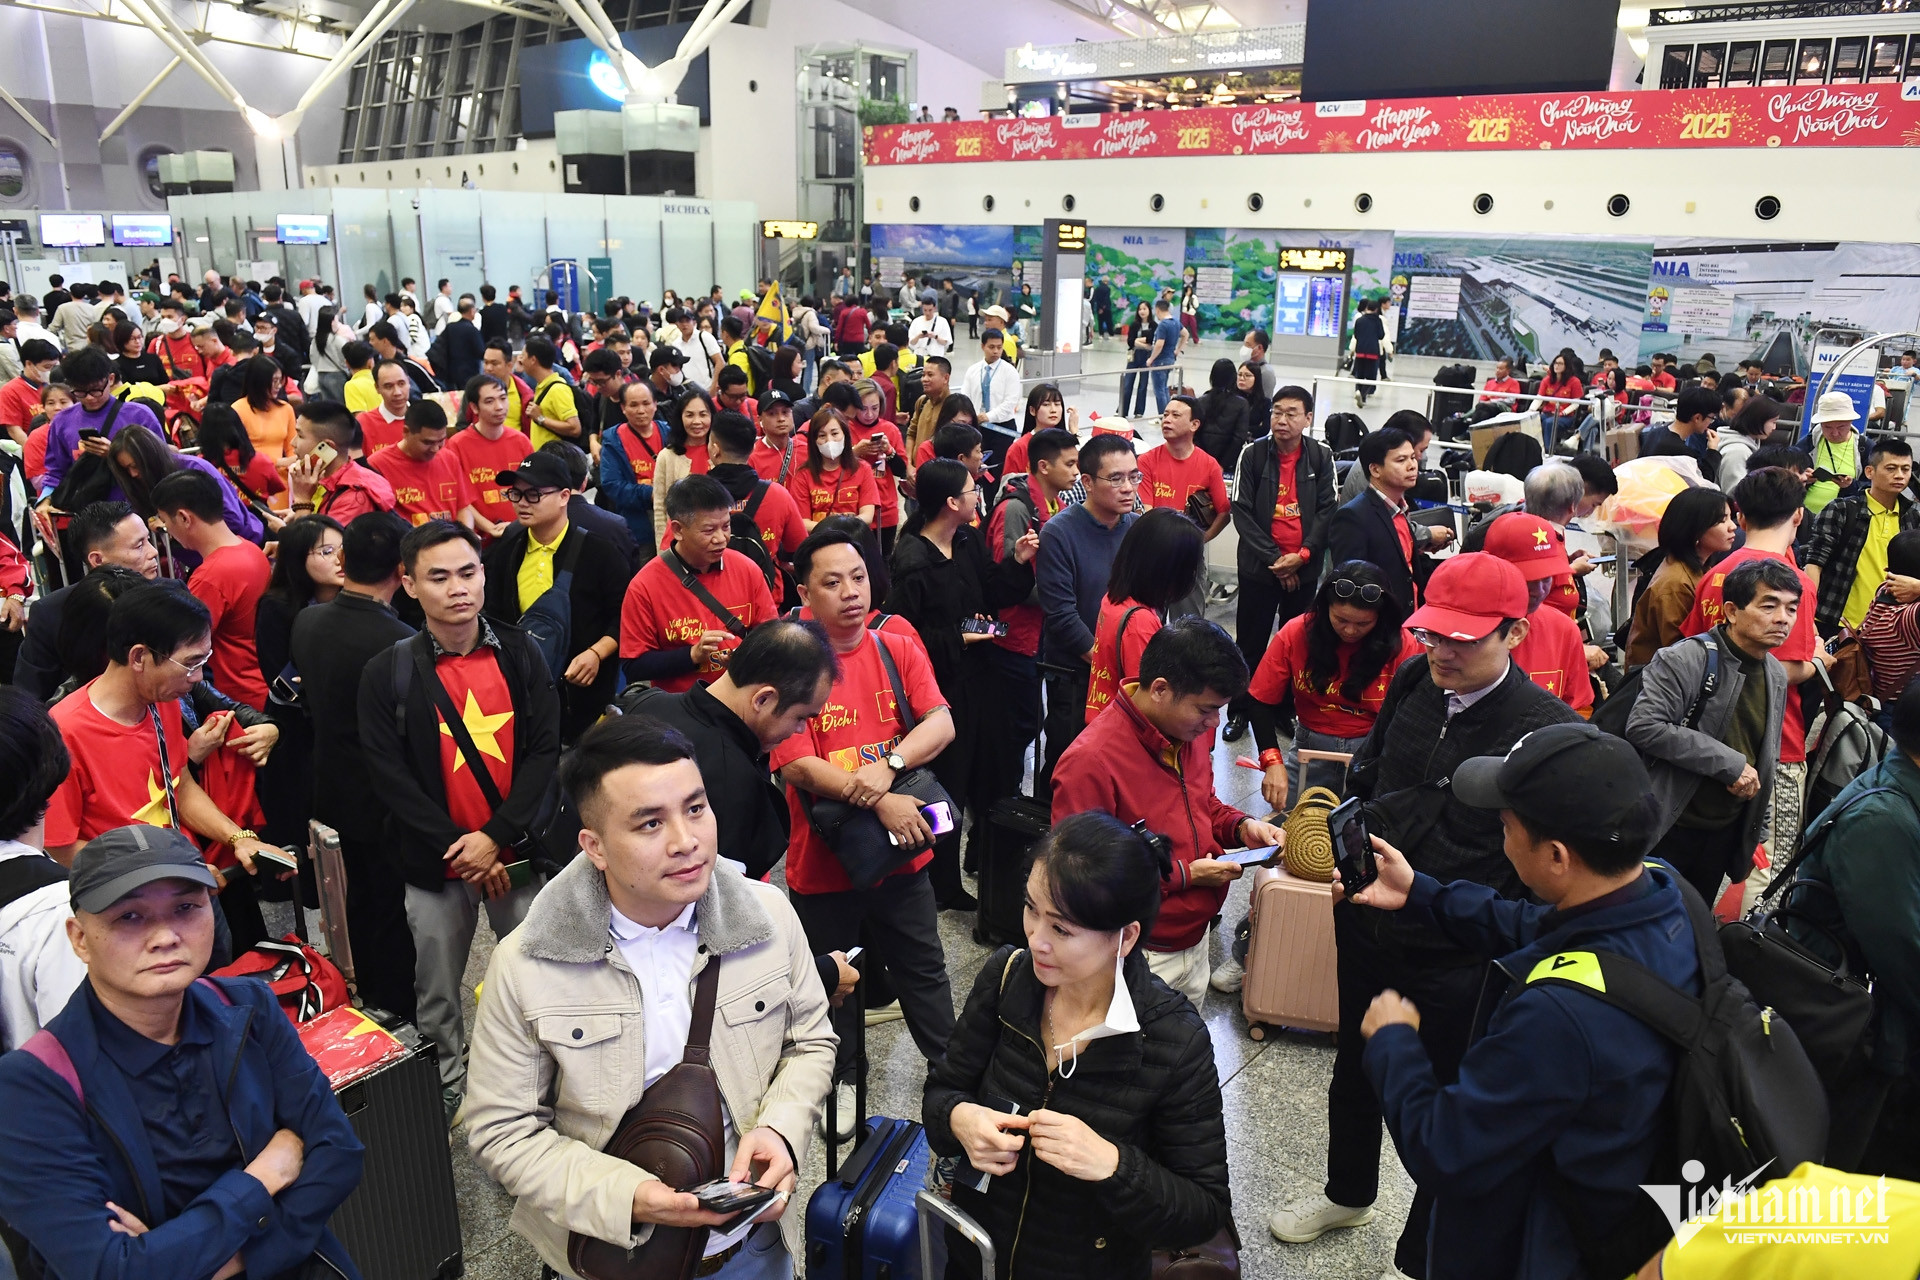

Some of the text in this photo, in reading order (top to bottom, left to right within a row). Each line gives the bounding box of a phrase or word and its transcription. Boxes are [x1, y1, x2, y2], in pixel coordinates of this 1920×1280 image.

[1319, 104, 1340, 113] ACV
[1371, 106, 1432, 131] Happy
[1103, 118, 1150, 139] Happy
[1356, 120, 1441, 150] New Year
[1467, 118, 1511, 142] 2025
[1679, 113, 1733, 139] 2025
[898, 129, 934, 148] Happy
[955, 137, 981, 156] 2025
[1094, 131, 1158, 156] New Year
[1177, 128, 1211, 149] 2025
[890, 140, 940, 163] New Year
[664, 204, 711, 215] RECHECK
[1123, 236, 1143, 245] NIA
[1394, 253, 1425, 266] NIA
[1653, 261, 1691, 276] NIA
[825, 702, 844, 714] Nam
[821, 709, 857, 732] Địch!
